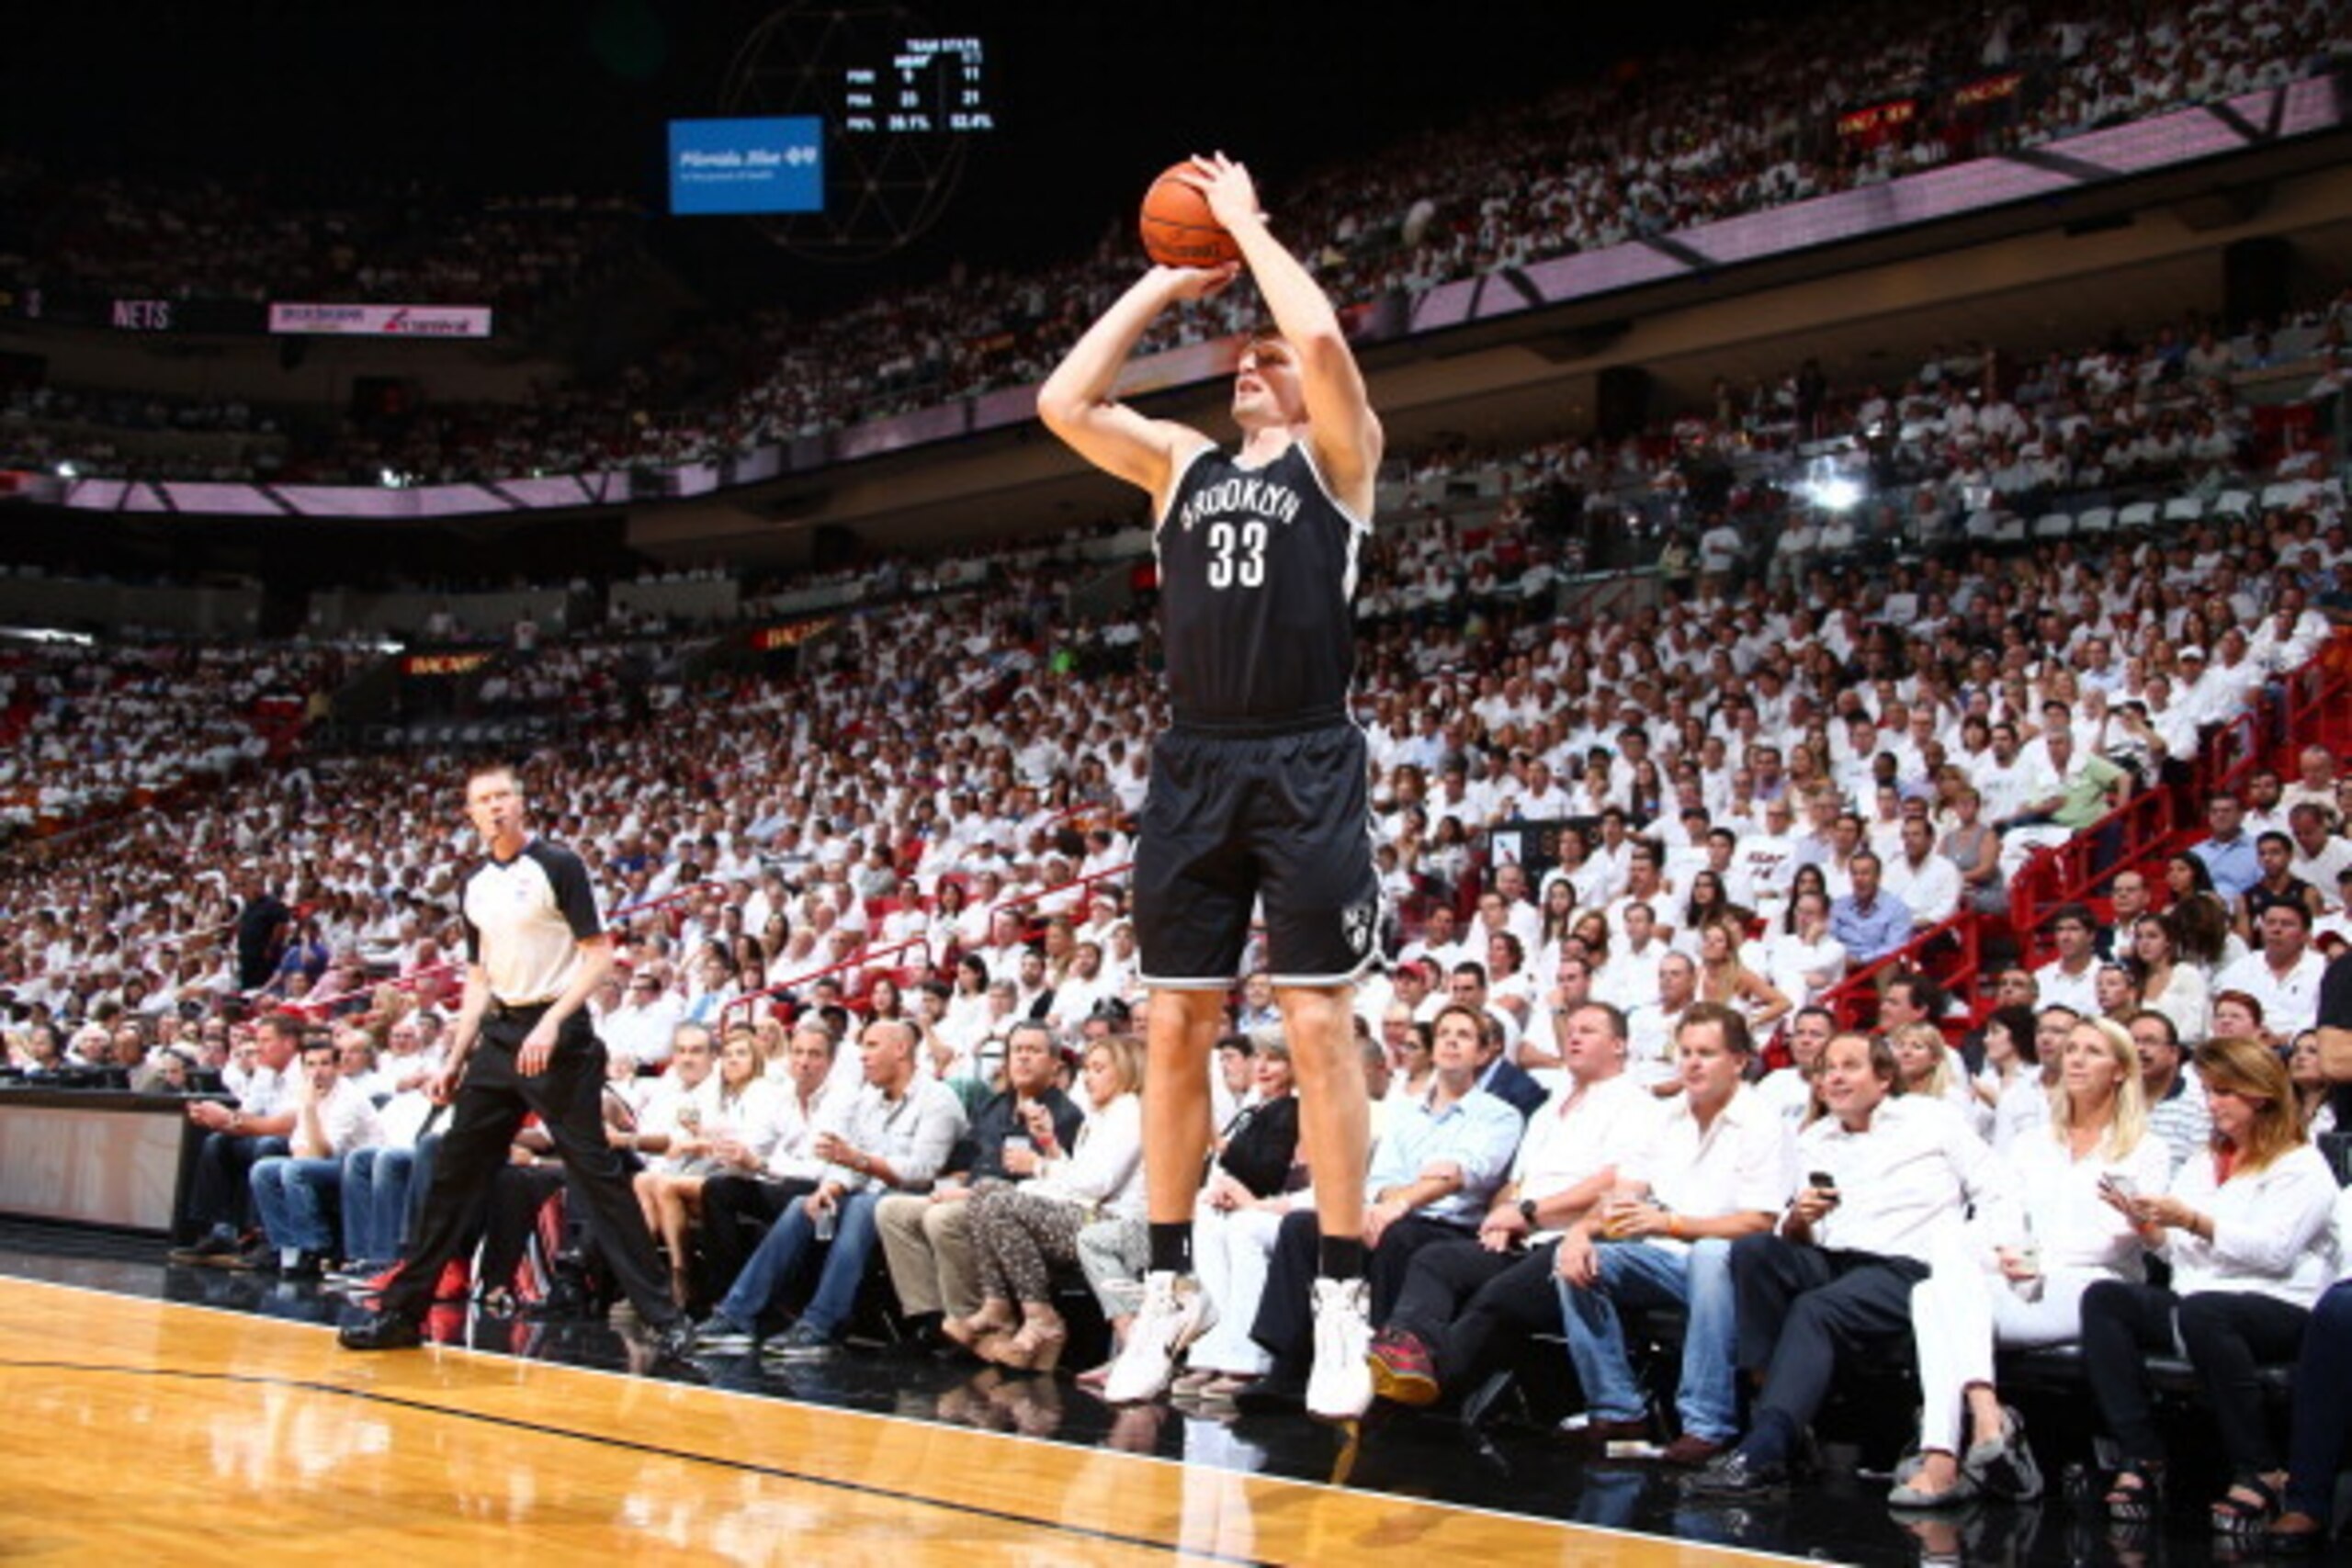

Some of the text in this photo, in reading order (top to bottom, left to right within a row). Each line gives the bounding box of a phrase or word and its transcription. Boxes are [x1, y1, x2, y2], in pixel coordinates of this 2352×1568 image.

[964, 67, 979, 81] 11
[113, 300, 169, 330] NETS
[1180, 478, 1303, 531] BROOKLYN
[1208, 521, 1269, 588] 33
